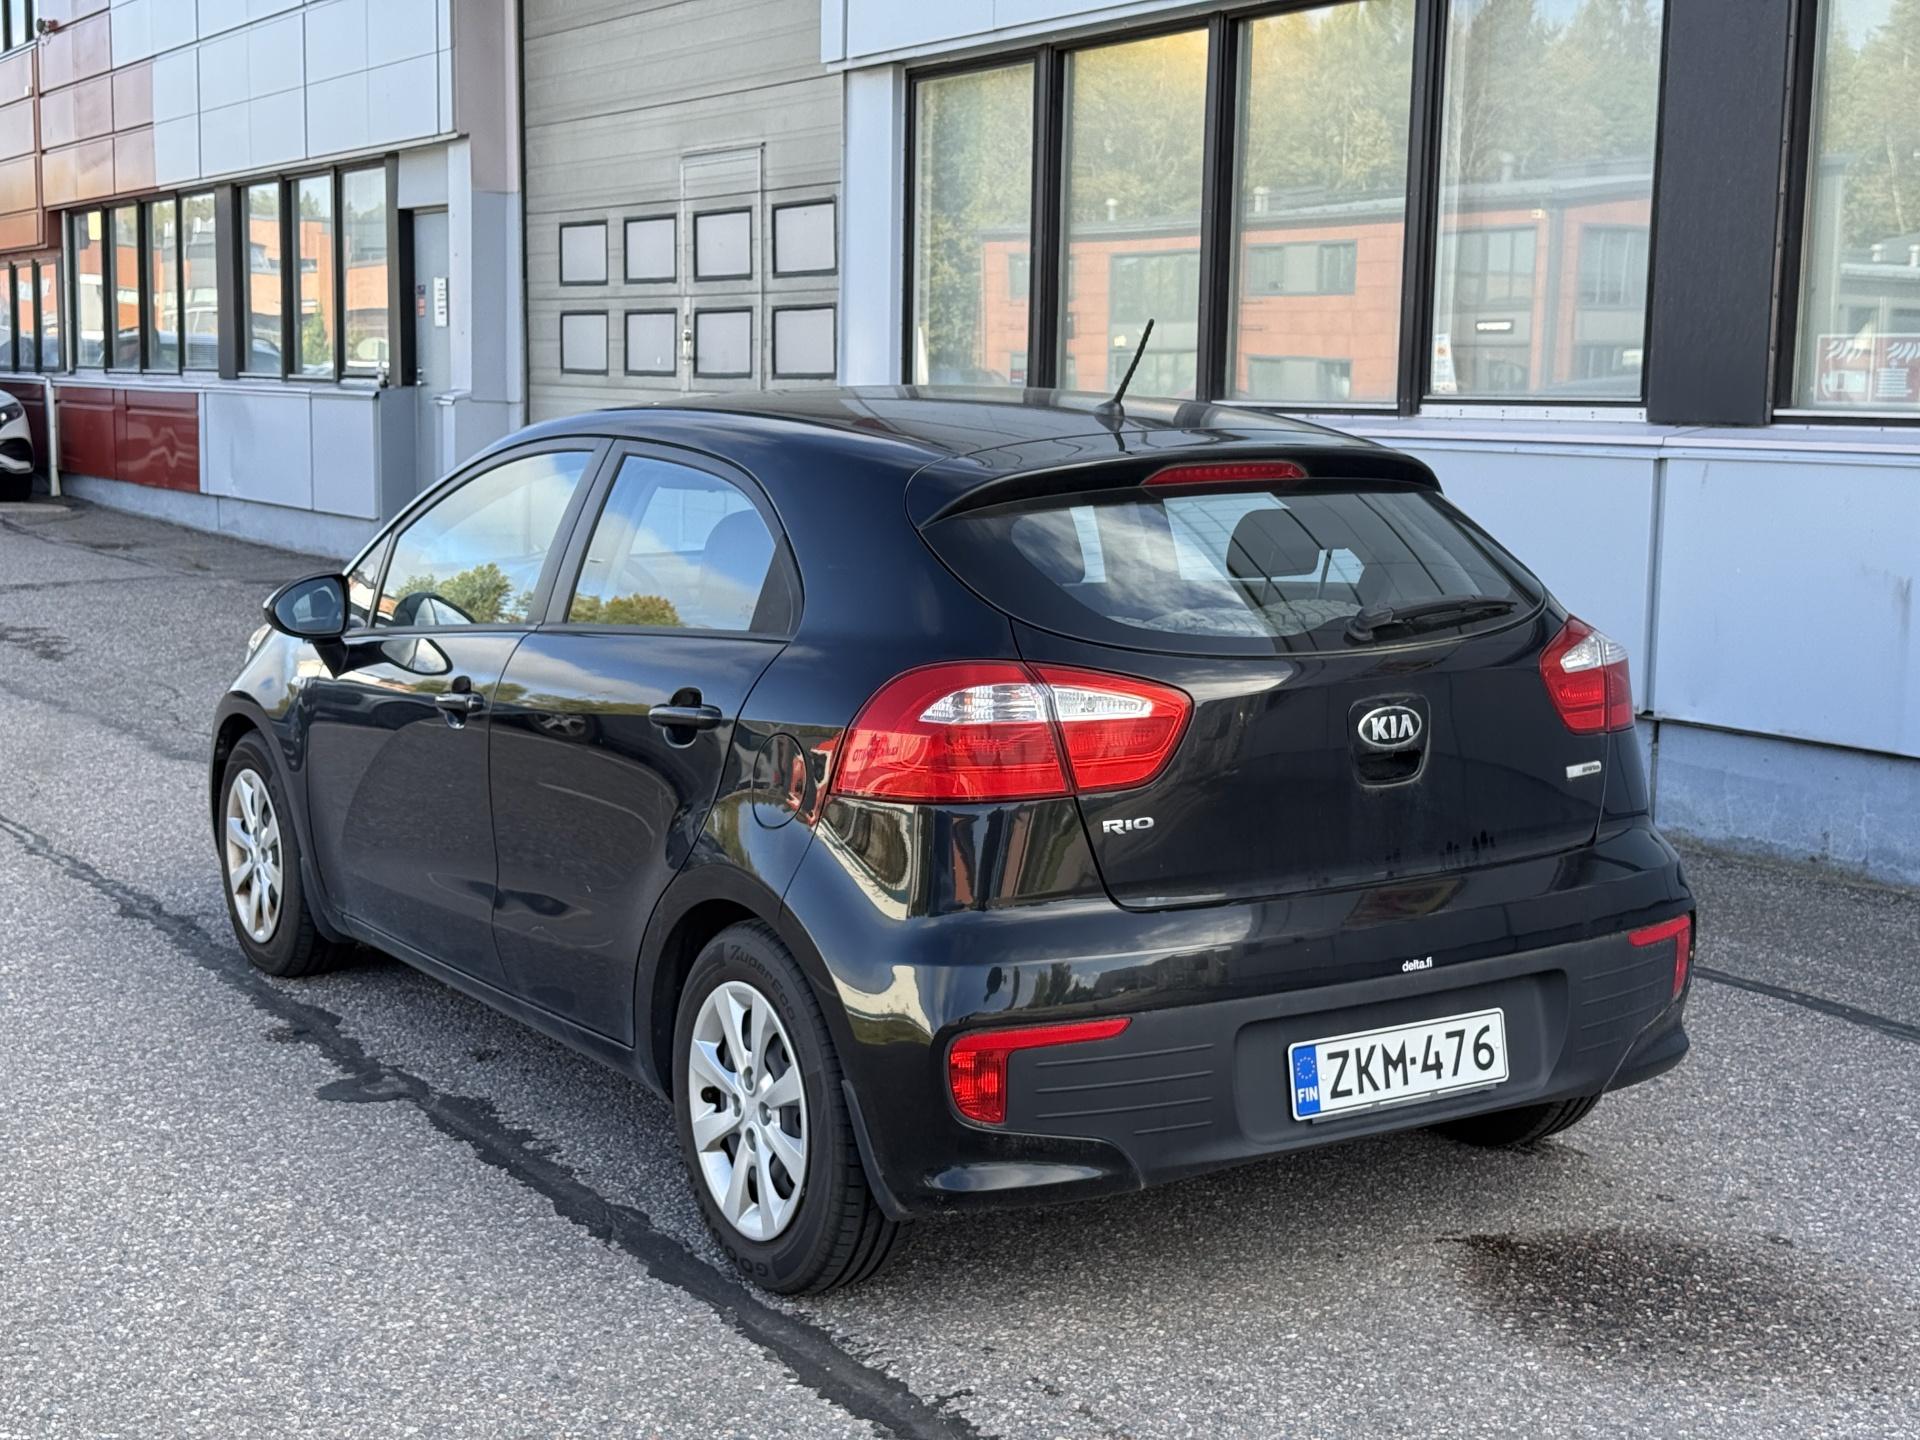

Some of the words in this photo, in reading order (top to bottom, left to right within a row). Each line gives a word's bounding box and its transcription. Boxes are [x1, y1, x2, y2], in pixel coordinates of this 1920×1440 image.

[1370, 713, 1414, 741] KIA
[1102, 816, 1155, 835] RIO
[1401, 956, 1433, 973] delta.fi
[1326, 1024, 1495, 1100] ZKM-476
[1297, 1085, 1319, 1104] FIN
